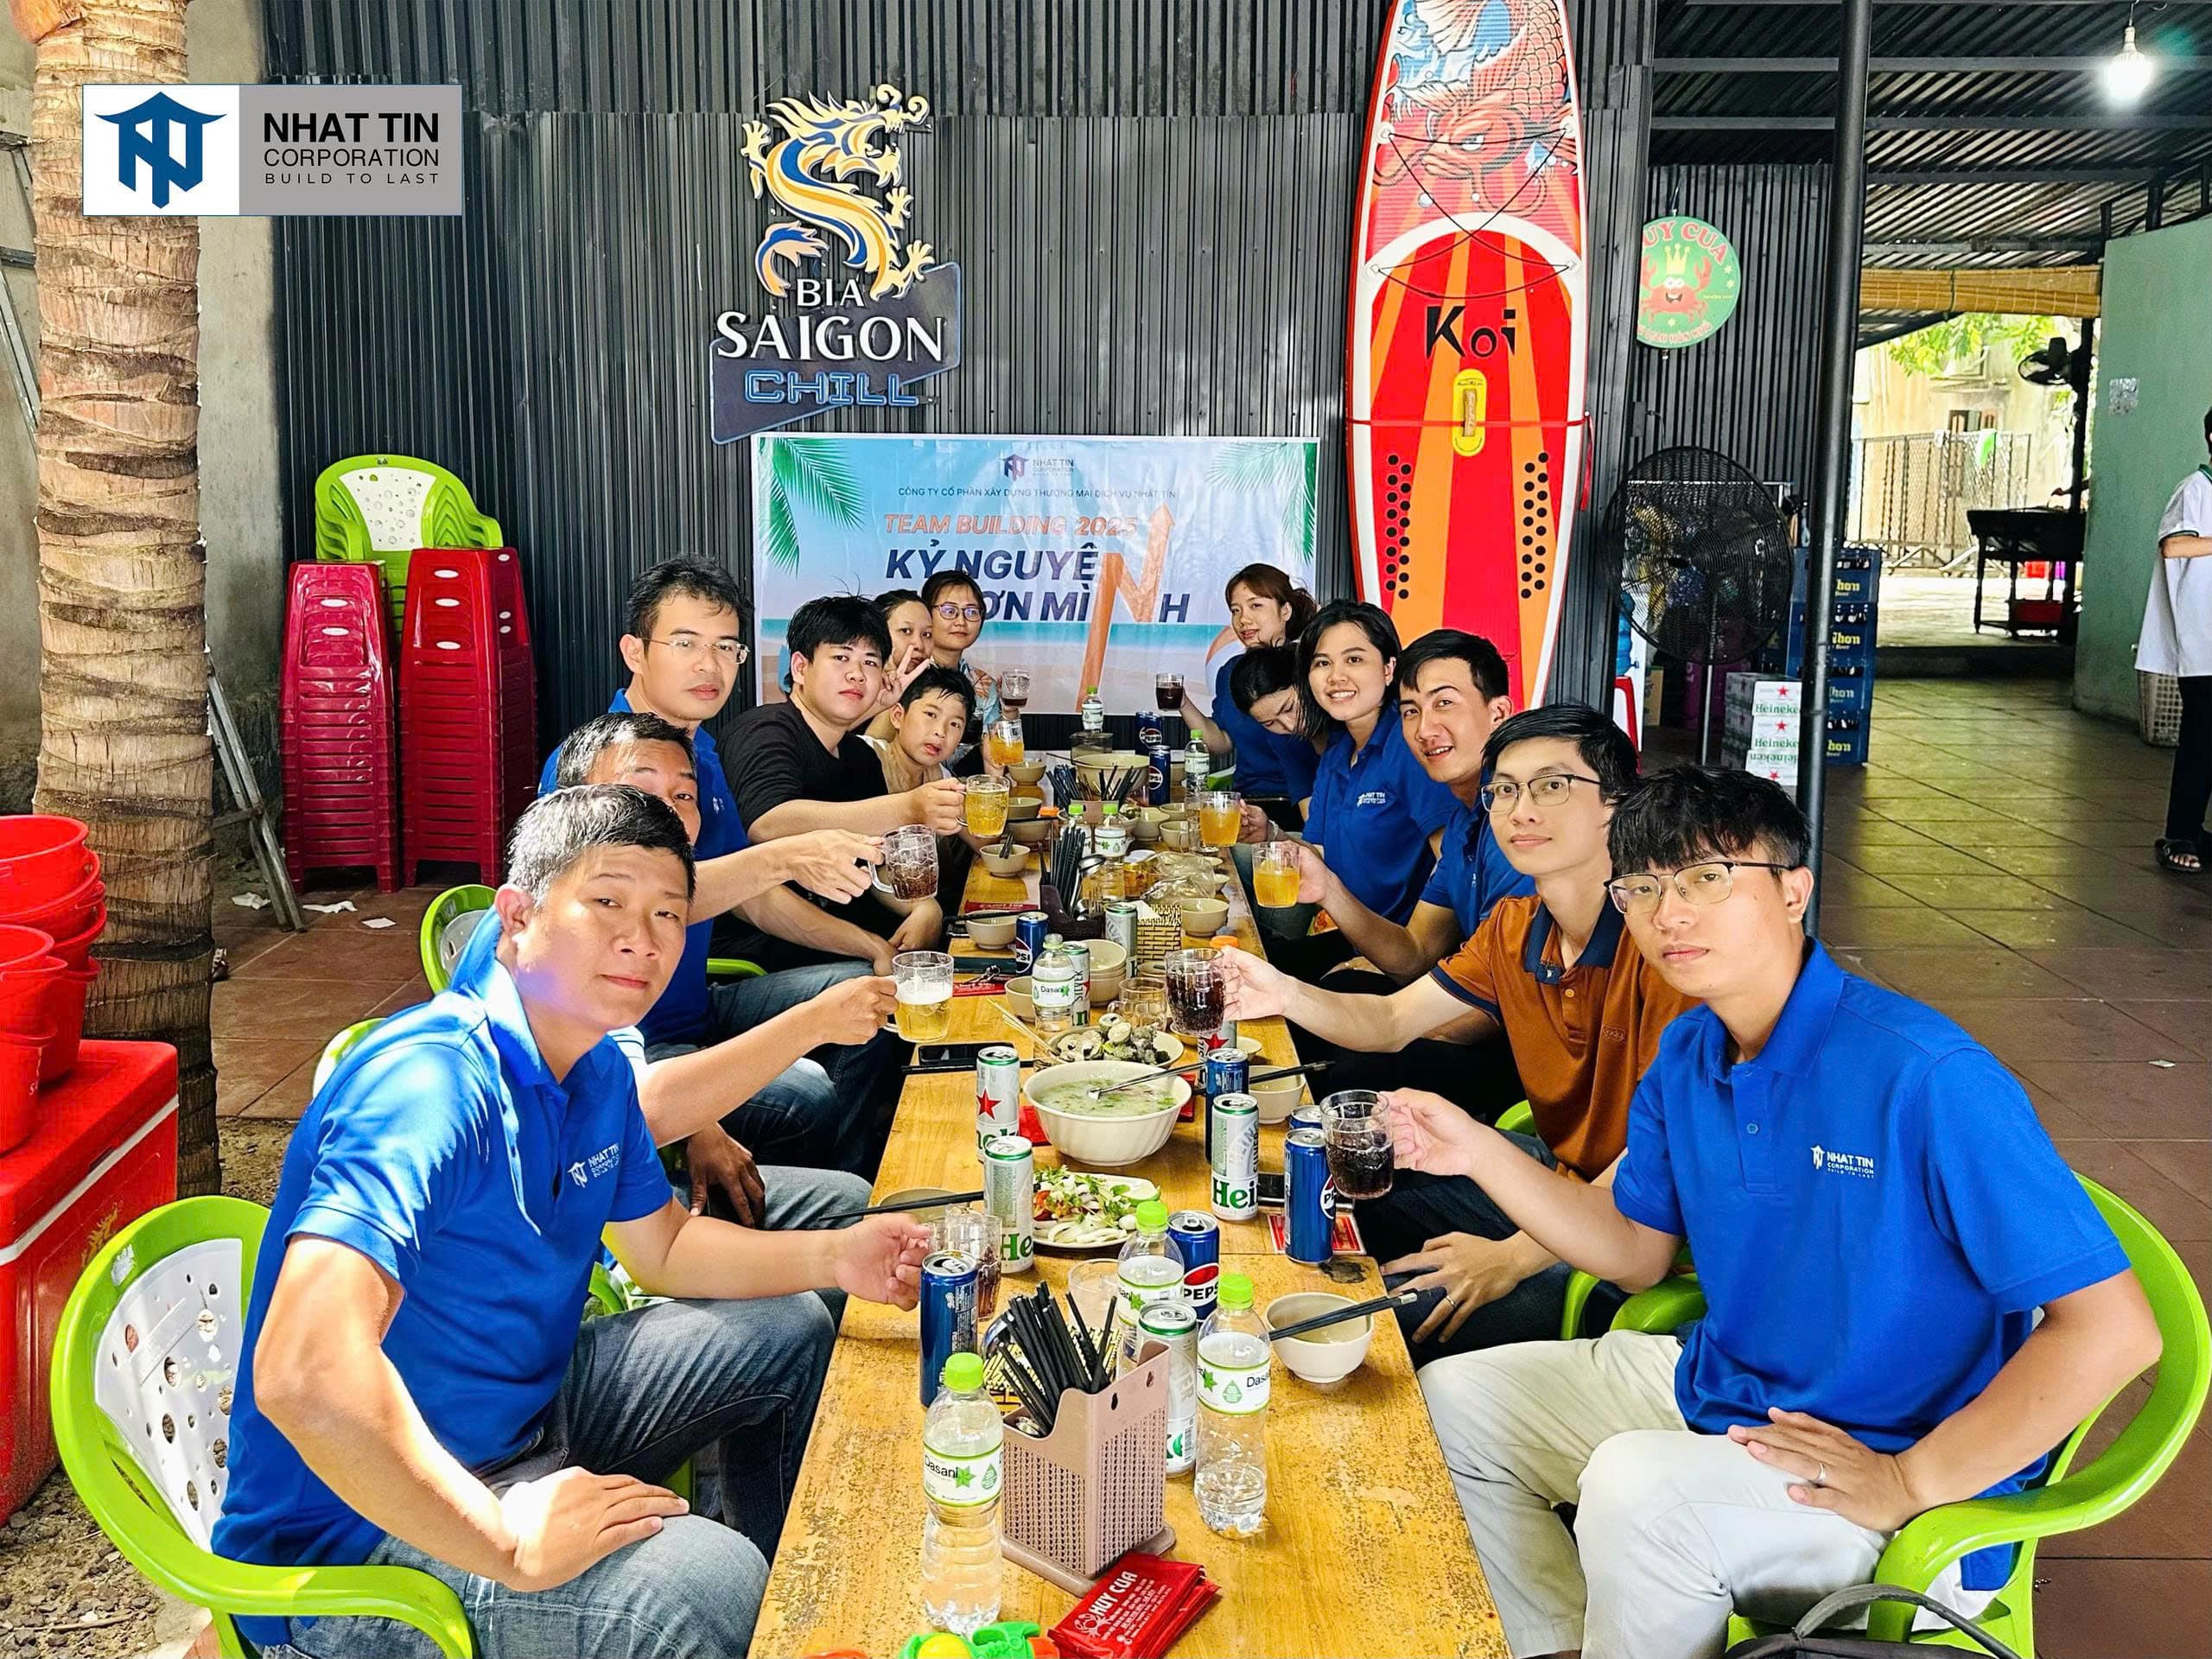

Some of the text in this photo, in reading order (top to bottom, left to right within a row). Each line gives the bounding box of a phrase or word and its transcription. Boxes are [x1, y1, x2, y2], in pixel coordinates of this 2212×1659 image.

[1643, 221, 1728, 265] UY CUA
[797, 278, 865, 307] BIA
[717, 310, 944, 362] SAIGON
[1426, 305, 1516, 359] Koi
[745, 370, 919, 406] CHILL
[927, 487, 938, 496] TY
[884, 514, 1138, 536] TEAM BUILDING 2025
[1755, 703, 1799, 715] Heineke
[1755, 737, 1799, 748] Heineke
[1827, 1151, 1874, 1169] NHAT TIN
[1001, 1232, 1034, 1262] He
[925, 1454, 959, 1478] Dasani
[1089, 1592, 1119, 1616] HUY
[1109, 1570, 1138, 1593] CUA
